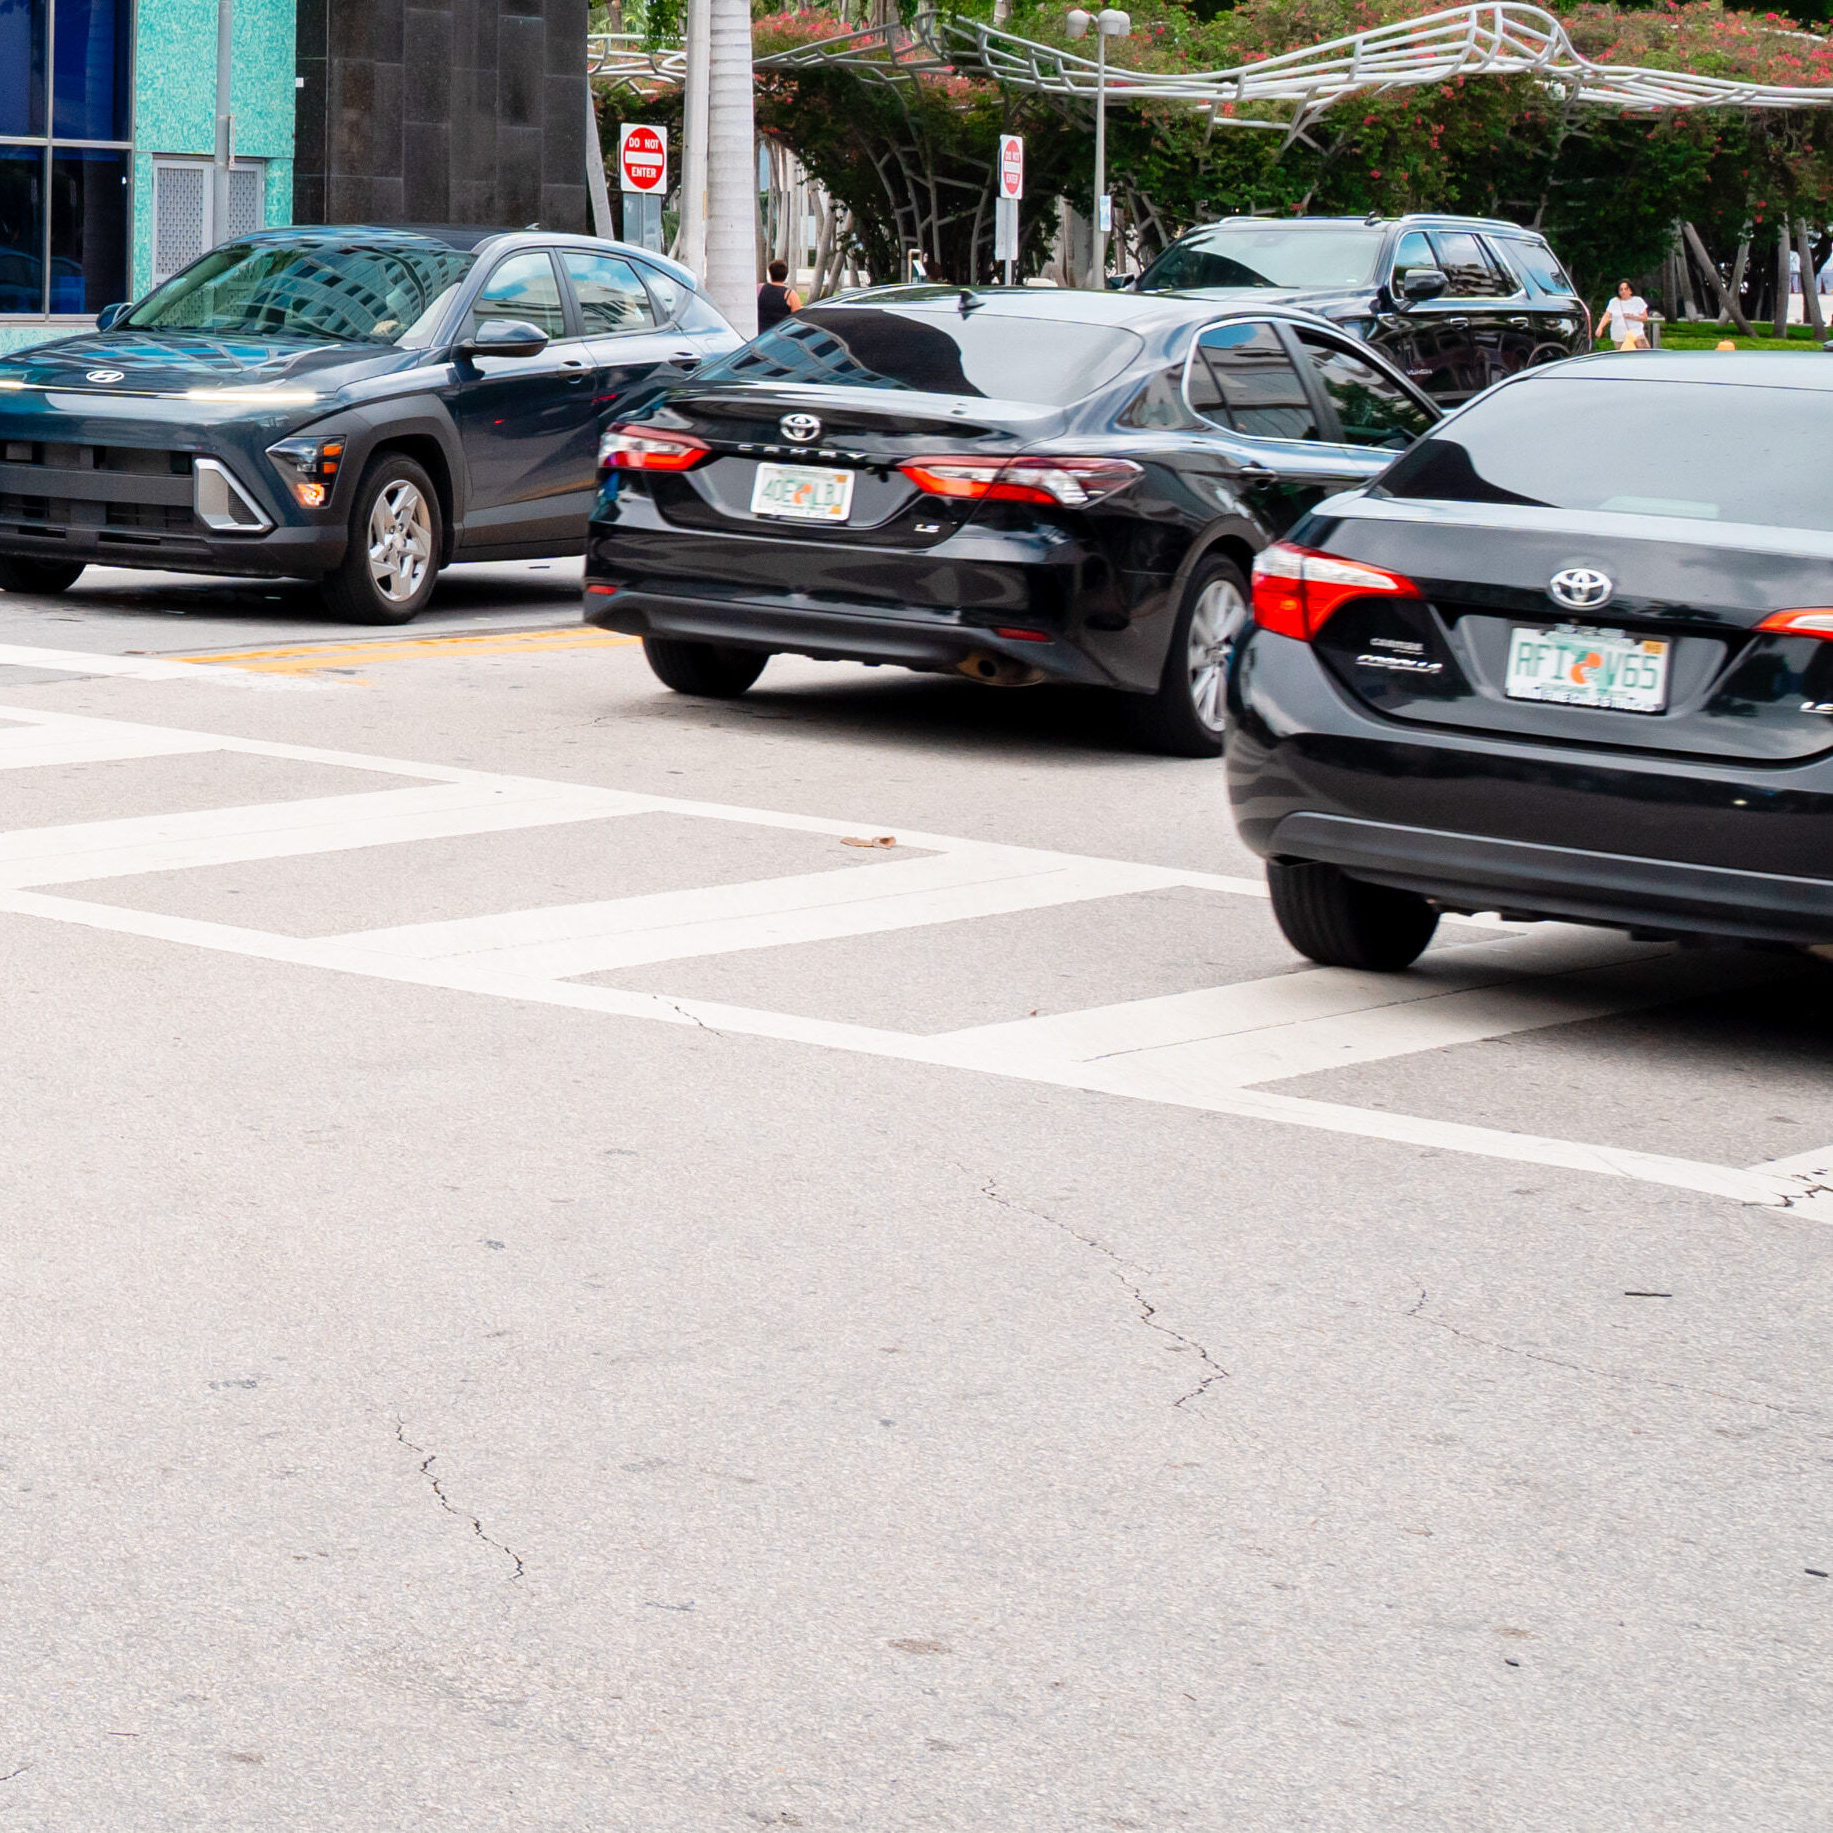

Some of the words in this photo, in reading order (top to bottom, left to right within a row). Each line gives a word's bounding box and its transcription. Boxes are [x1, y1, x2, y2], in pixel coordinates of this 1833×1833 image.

[628, 137, 640, 148] DO
[644, 138, 659, 150] NOT
[631, 166, 657, 179] ENTER
[737, 443, 867, 460] CAMRY
